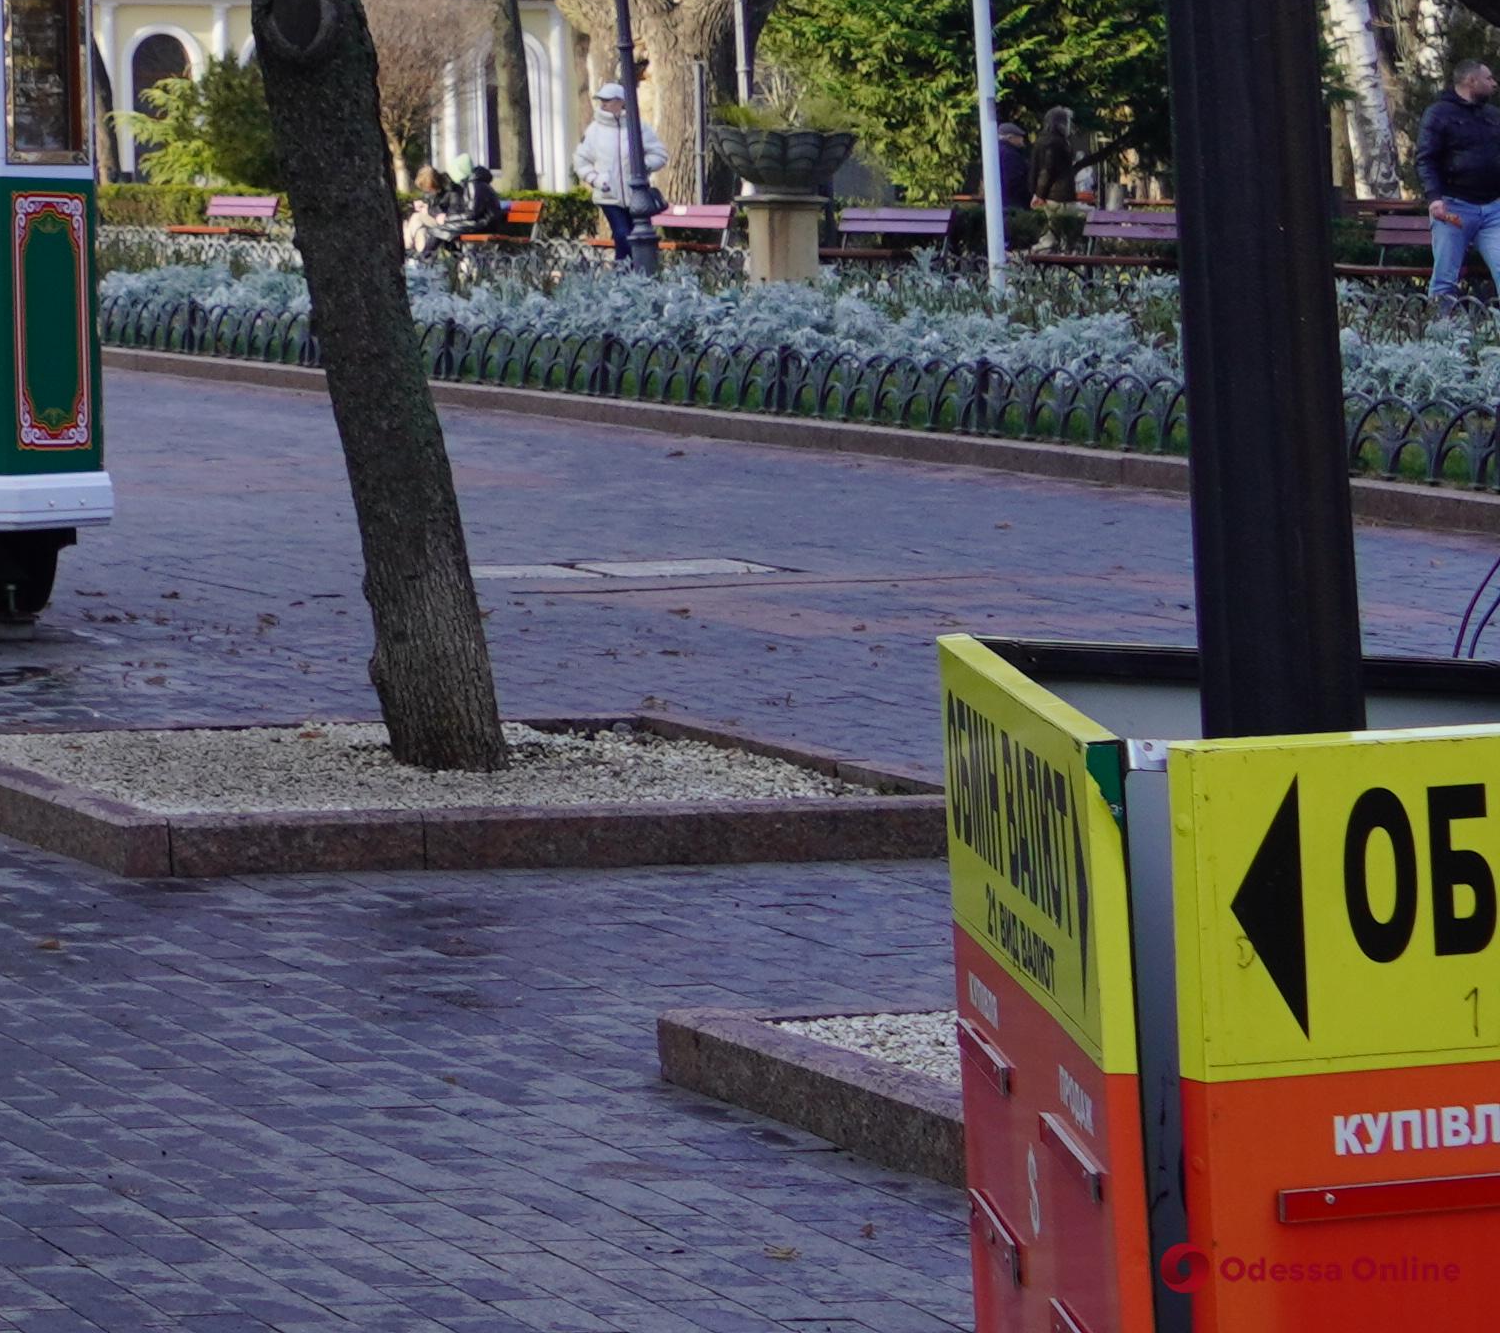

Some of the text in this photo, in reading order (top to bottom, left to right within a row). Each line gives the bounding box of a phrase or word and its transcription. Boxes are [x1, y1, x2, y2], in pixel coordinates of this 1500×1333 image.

[947, 689, 1073, 939] ОБМІН ВАЛЮТ
[1344, 782, 1498, 964] ОБ
[986, 882, 998, 942] 21
[1019, 919, 1056, 996] ВАЛЮТ
[1333, 1103, 1500, 1156] КУПІВЛ
